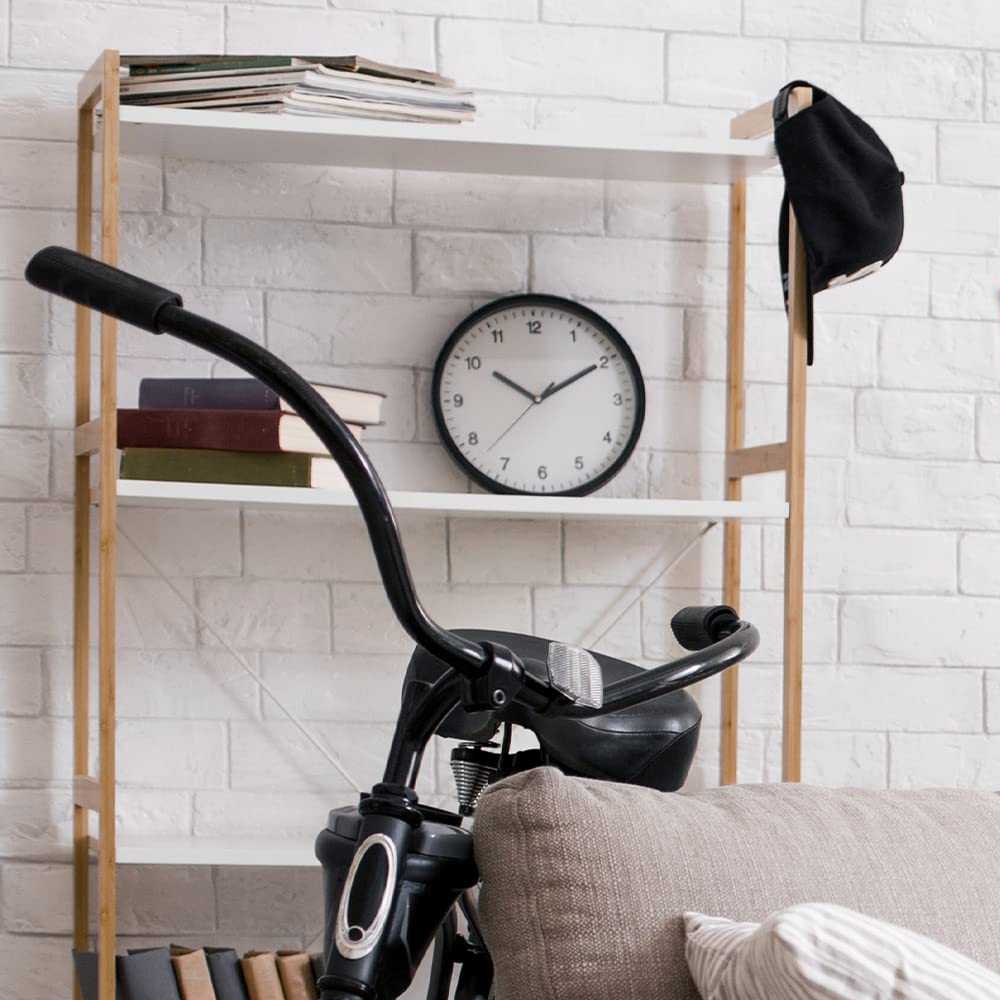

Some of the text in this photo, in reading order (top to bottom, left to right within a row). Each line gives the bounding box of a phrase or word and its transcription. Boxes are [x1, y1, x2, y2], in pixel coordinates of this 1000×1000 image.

[526, 320, 542, 335] 12
[491, 329, 504, 343] 11
[569, 330, 577, 343] 1
[465, 355, 482, 370] 10
[599, 355, 609, 369] 2
[453, 393, 464, 408] 9
[613, 393, 623, 406] 3
[468, 432, 478, 445] 8
[602, 431, 612, 444] 4
[500, 457, 510, 471] 7
[574, 456, 584, 470] 5
[537, 465, 548, 479] 6
